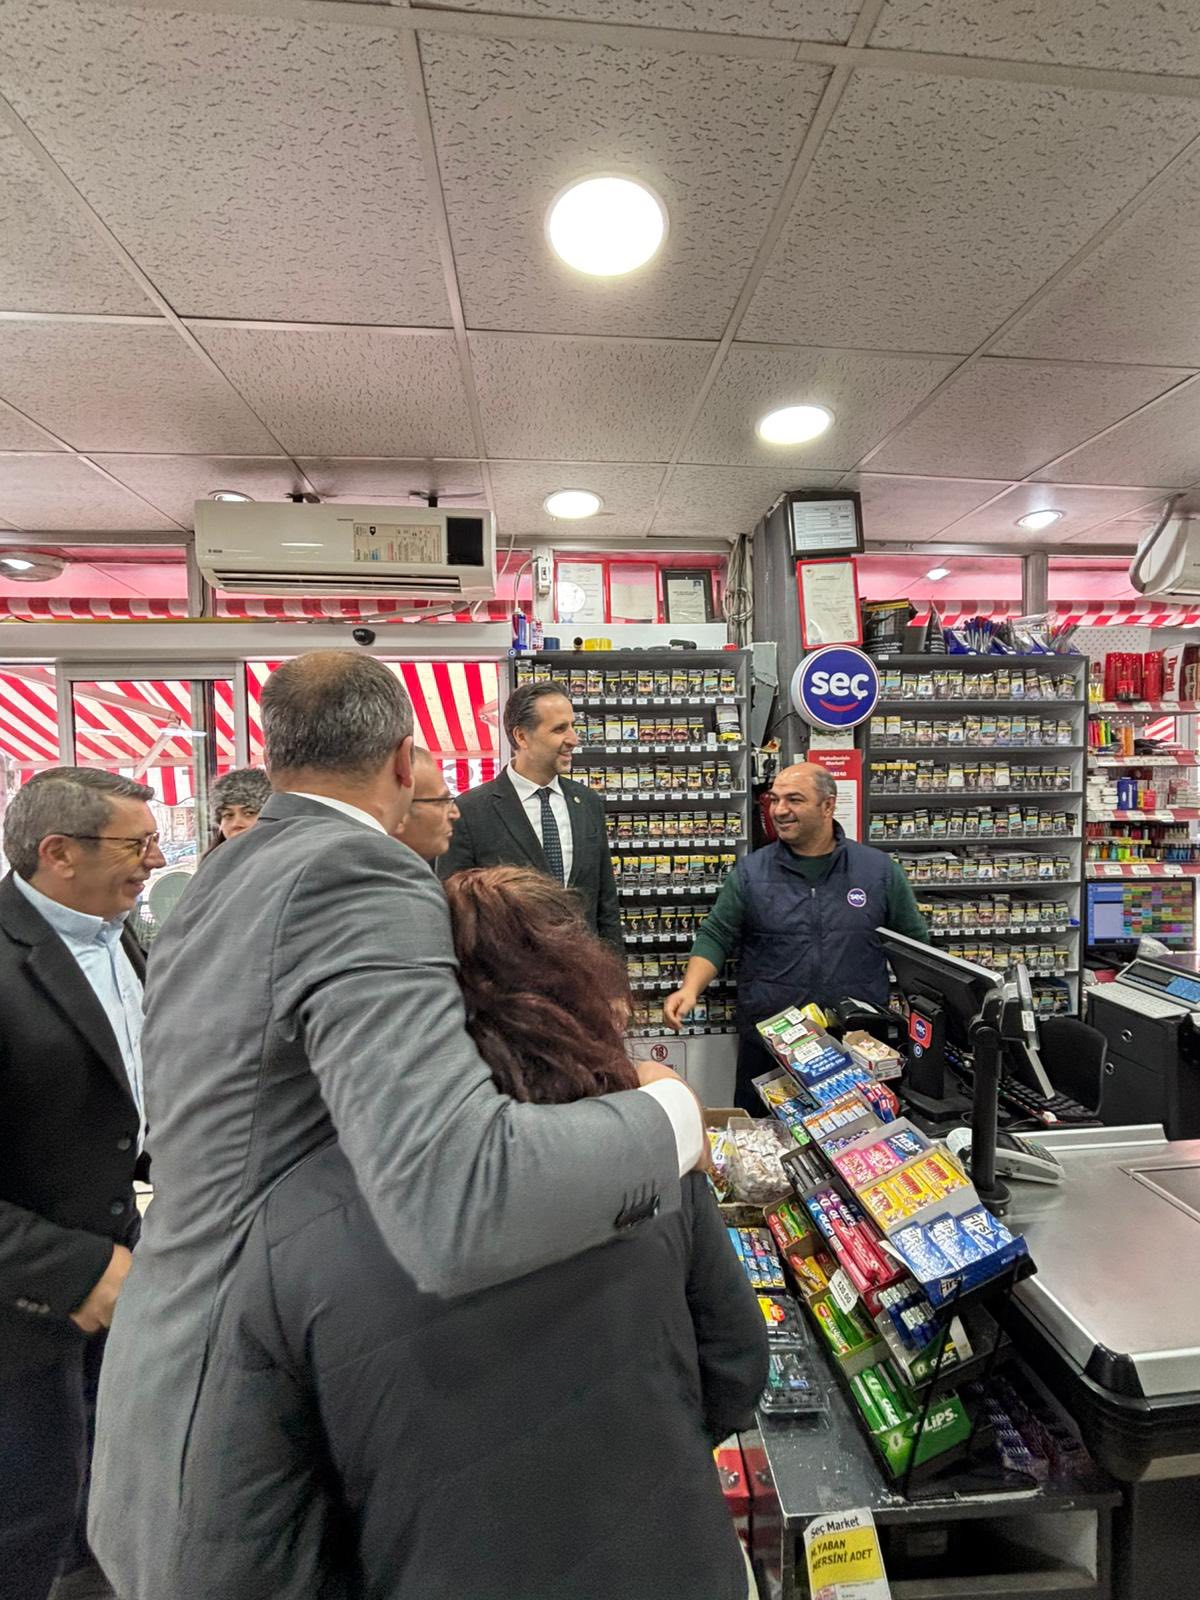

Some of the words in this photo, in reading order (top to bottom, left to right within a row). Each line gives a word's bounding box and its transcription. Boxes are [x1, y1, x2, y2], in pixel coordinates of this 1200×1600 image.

[810, 670, 870, 701] seç
[893, 1132, 923, 1153] First
[965, 1213, 998, 1236] First
[826, 1515, 860, 1532] Market
[816, 1539, 847, 1553] YABAN
[849, 1547, 873, 1562] ADET
